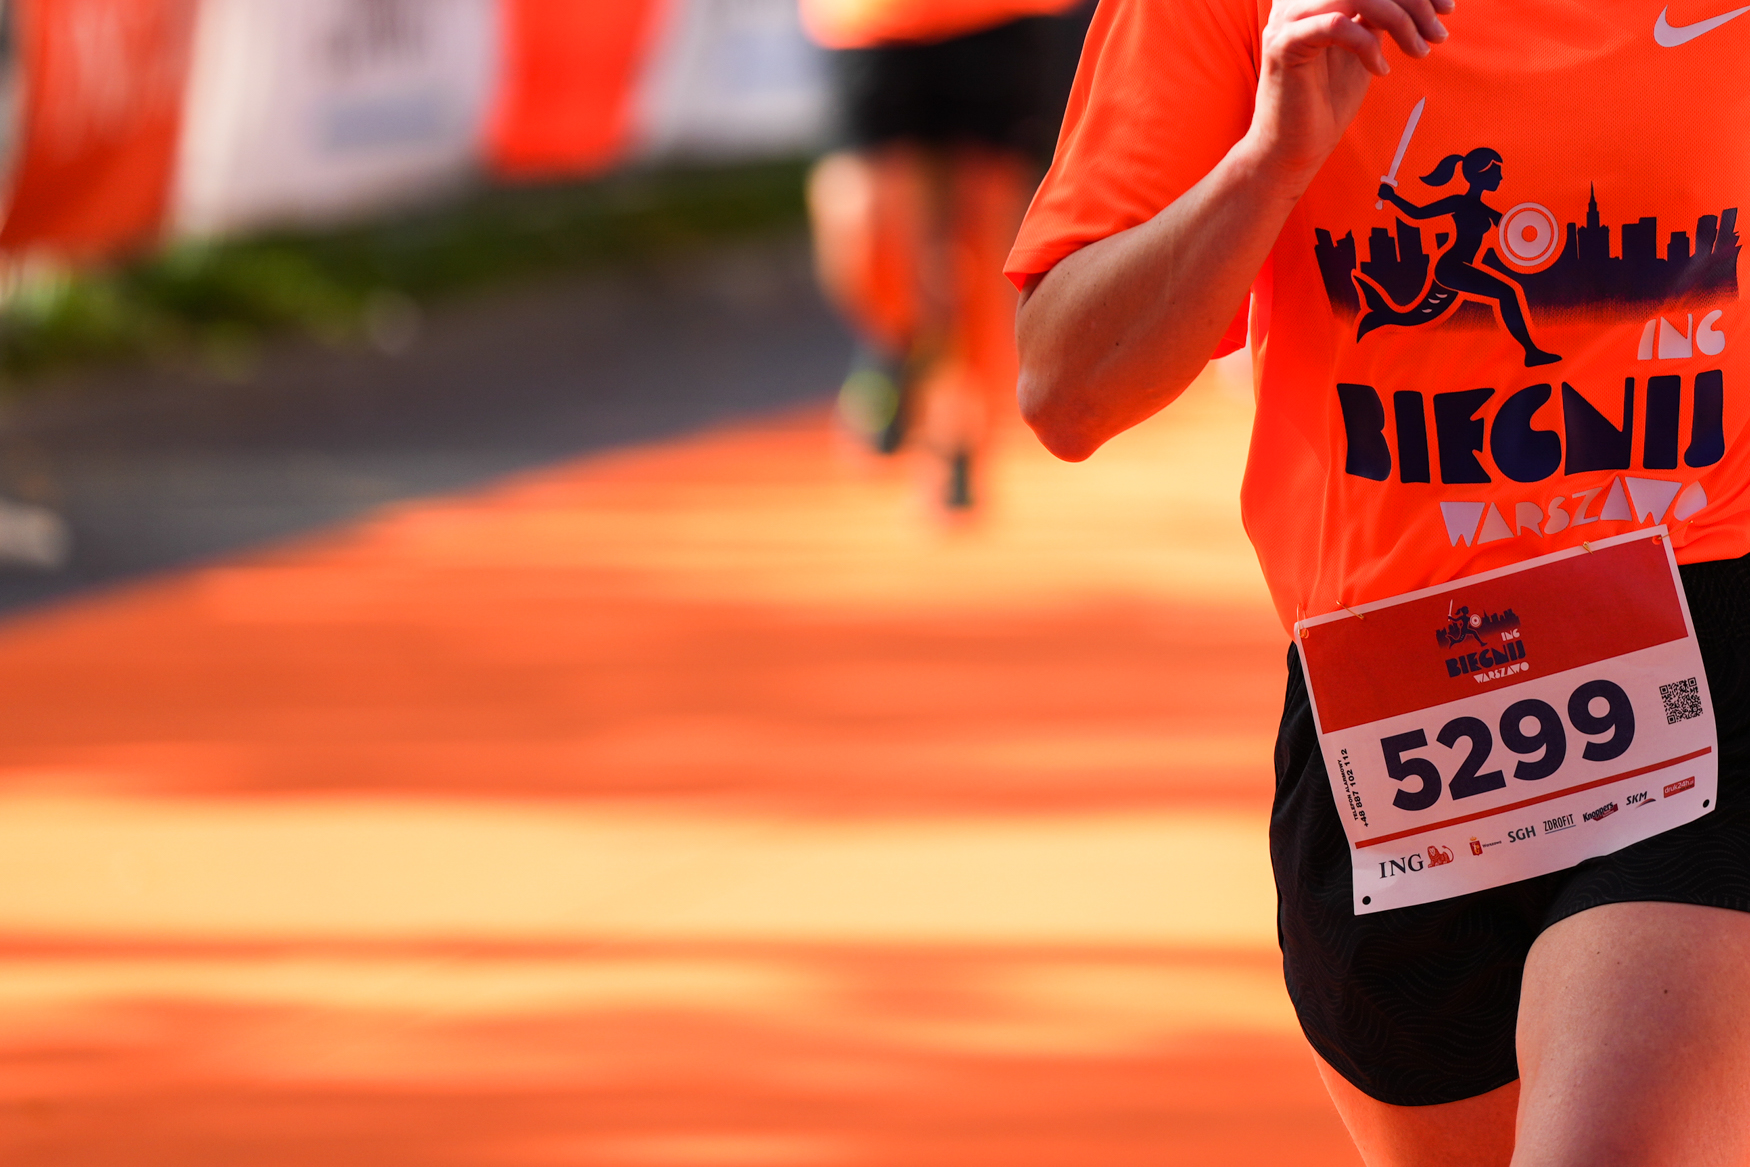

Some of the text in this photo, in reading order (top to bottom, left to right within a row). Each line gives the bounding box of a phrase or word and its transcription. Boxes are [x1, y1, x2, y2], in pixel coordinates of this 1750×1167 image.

[1637, 309, 1727, 361] ING
[1335, 369, 1727, 485] BIEGNIJ
[1501, 628, 1520, 641] ING
[1445, 640, 1526, 678] BIEGNIJ
[1473, 661, 1530, 684] WARSZAWO
[1380, 679, 1636, 811] 5299
[1341, 748, 1369, 827] +48 887 102 112
[1626, 791, 1648, 806] SKM
[1347, 794, 1359, 821] TELEFON
[1582, 802, 1614, 823] Knoppers
[1507, 825, 1537, 843] SGH
[1378, 853, 1425, 880] ING
